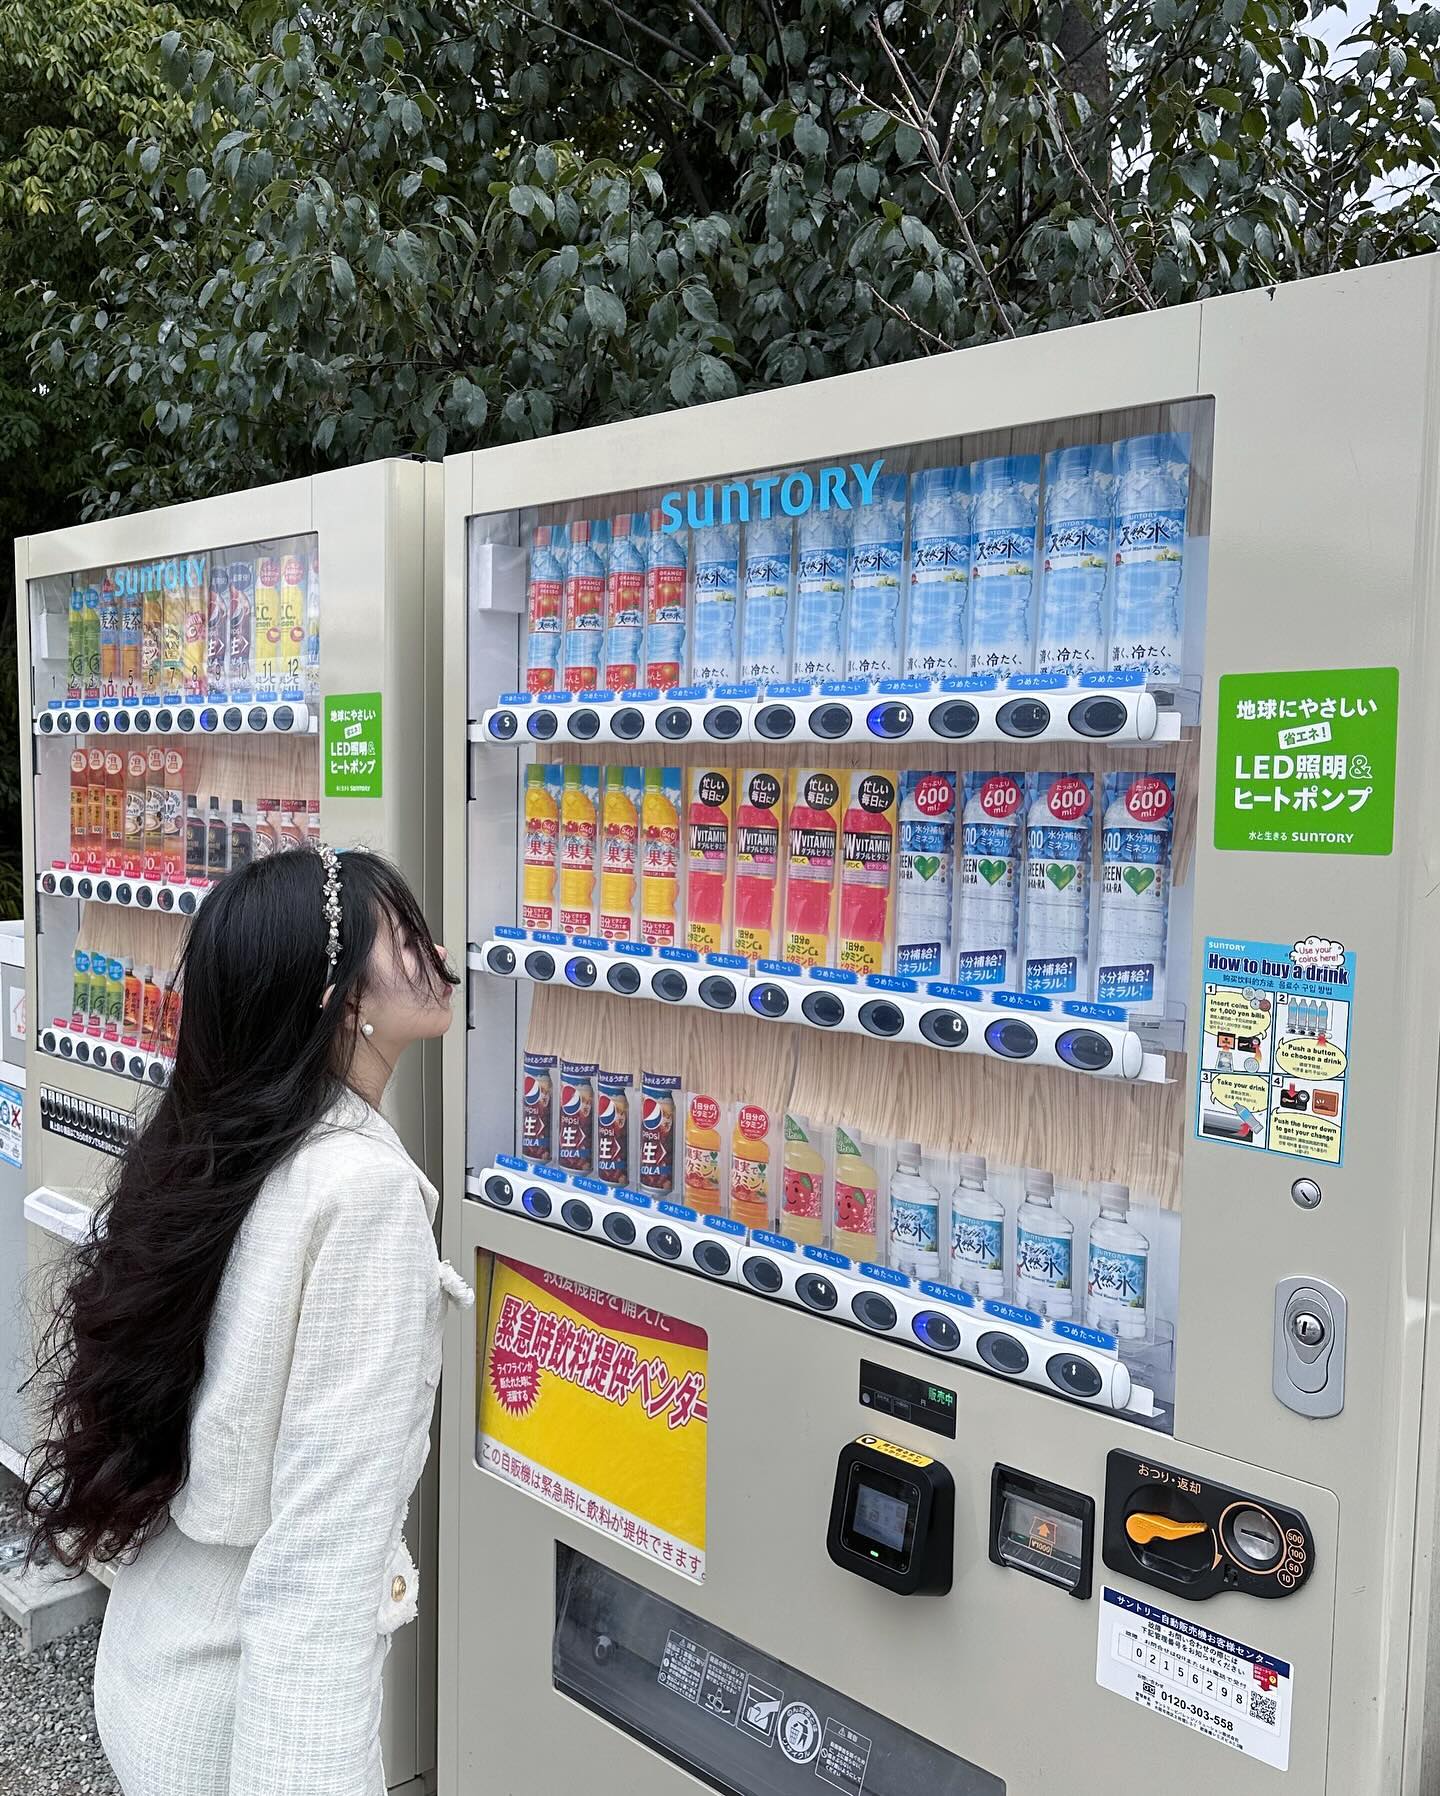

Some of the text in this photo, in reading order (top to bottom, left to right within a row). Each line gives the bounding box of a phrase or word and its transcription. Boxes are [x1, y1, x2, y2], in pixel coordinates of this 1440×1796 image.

[661, 459, 885, 534] SUNTORY
[1048, 530, 1097, 553] 天然水
[1119, 522, 1170, 547] 天然水
[915, 544, 958, 567] 天然水
[976, 539, 1021, 560] 天然水
[114, 557, 205, 597] SUNTORY
[1236, 697, 1377, 720] 地球にやさしい
[1284, 726, 1326, 745] 省エネ!
[330, 759, 376, 775] ヒートポンプ
[703, 778, 724, 789] 忙しい
[753, 779, 775, 791] 忙しい
[809, 779, 833, 792] 忙しい
[863, 781, 888, 794] 忙しい
[918, 786, 948, 806] 600
[984, 787, 1016, 807] 600
[1051, 789, 1085, 810] 600
[1130, 789, 1166, 811] 600
[1234, 785, 1373, 812] ヒートポンプ
[1248, 832, 1353, 843] 水と生きる SUNTORY
[530, 840, 556, 856] 果実
[567, 843, 594, 859] 果実
[608, 847, 635, 864] 果実
[649, 850, 677, 867] 果実
[1208, 941, 1245, 951] SUNTORY
[1299, 946, 1332, 955] Use your
[1298, 953, 1338, 963] coins here!
[1208, 953, 1348, 985] How to buy a drink
[1026, 977, 1066, 990] ミネラル!
[1099, 984, 1143, 998] ミネラル!
[1210, 999, 1249, 1010] Insert coins
[1279, 994, 1285, 1002] 2
[1238, 1010, 1250, 1018] yen
[1251, 1012, 1265, 1020] bills
[1288, 1043, 1305, 1053] Push
[1313, 1047, 1336, 1057] button
[1290, 1052, 1316, 1062] choose
[1323, 1056, 1342, 1066] drink
[1217, 1078, 1265, 1092] Take your drink
[693, 1099, 716, 1111] 1日分の
[692, 1109, 718, 1119] ビタミン!
[742, 1109, 766, 1121] 1日分の
[740, 1119, 766, 1130] ビタミン!
[1274, 1117, 1290, 1125] Push
[1302, 1122, 1319, 1131] lever
[1320, 1125, 1337, 1134] down
[562, 1127, 577, 1147] 生
[1294, 1129, 1310, 1137] your
[1311, 1131, 1334, 1141] change
[642, 1142, 657, 1164] 生
[954, 1233, 995, 1259] 天然水
[1020, 1251, 1063, 1278] 天然水
[1092, 1268, 1137, 1297] 天然水
[494, 1293, 708, 1429] 緊急時飲料提供ベンダー
[497, 1361, 533, 1375] ライフラインが
[928, 1387, 953, 1407] 販売中
[1288, 1532, 1302, 1544] 500
[1290, 1548, 1304, 1559] 100
[1288, 1562, 1299, 1573] 50
[1281, 1573, 1291, 1584] 10
[1116, 1595, 1275, 1667] サントリー自動販売機お客様センター
[1161, 1691, 1234, 1732] 0120-303-558
